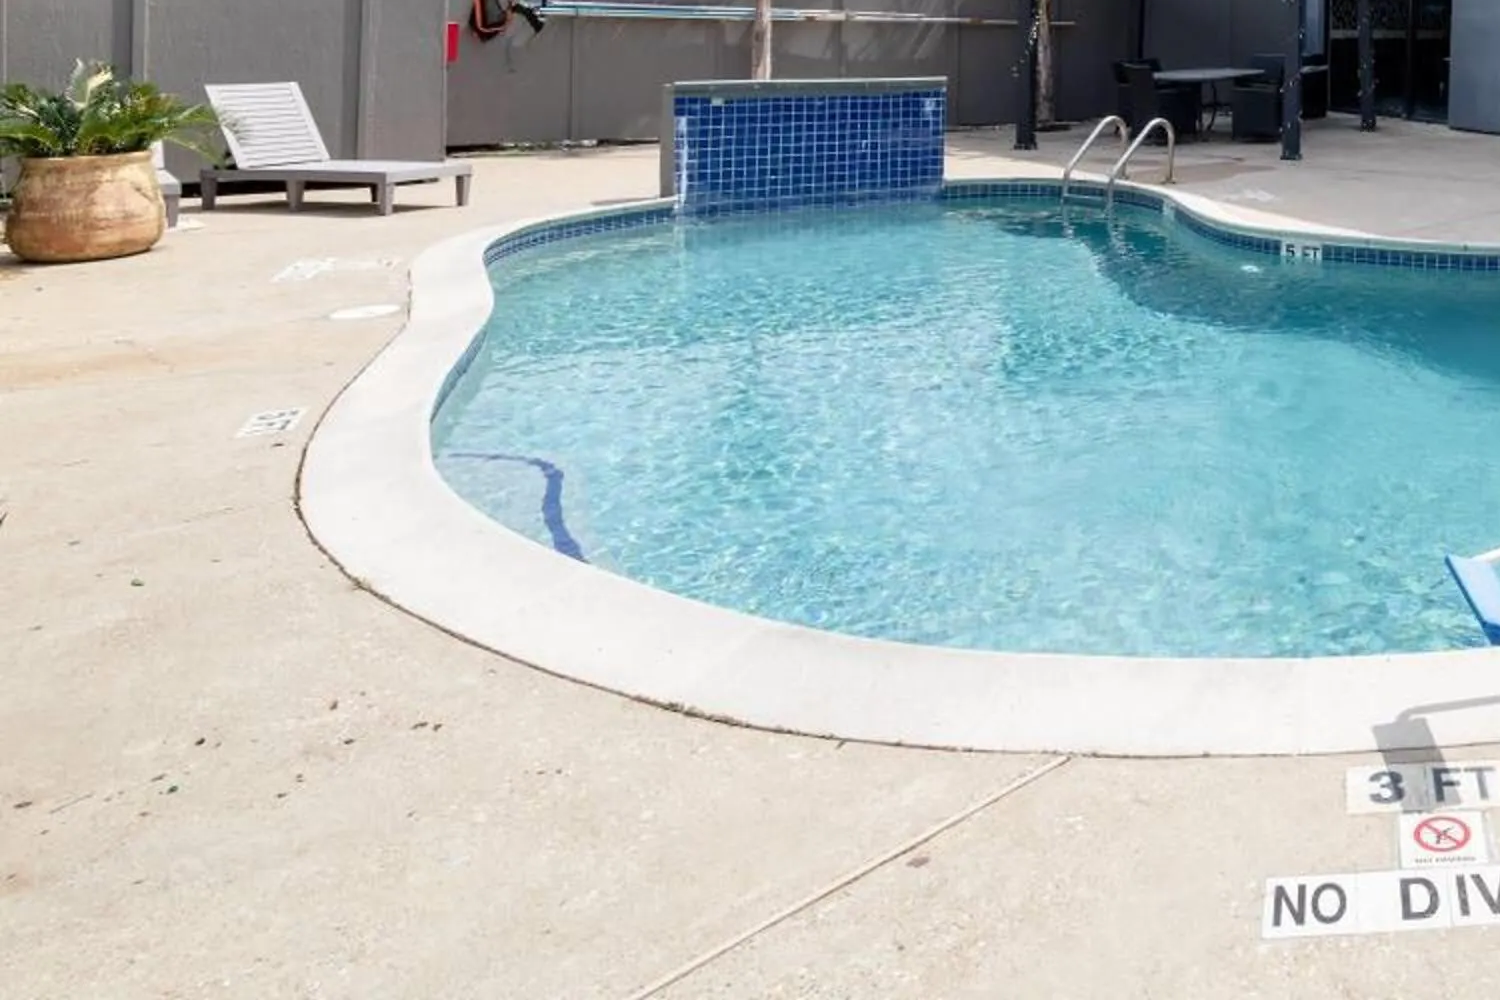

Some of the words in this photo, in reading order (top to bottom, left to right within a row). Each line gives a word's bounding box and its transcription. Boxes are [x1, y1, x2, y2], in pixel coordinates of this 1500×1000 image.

[1369, 770, 1405, 804] 3
[1432, 767, 1495, 801] FT
[1271, 882, 1347, 926] NO
